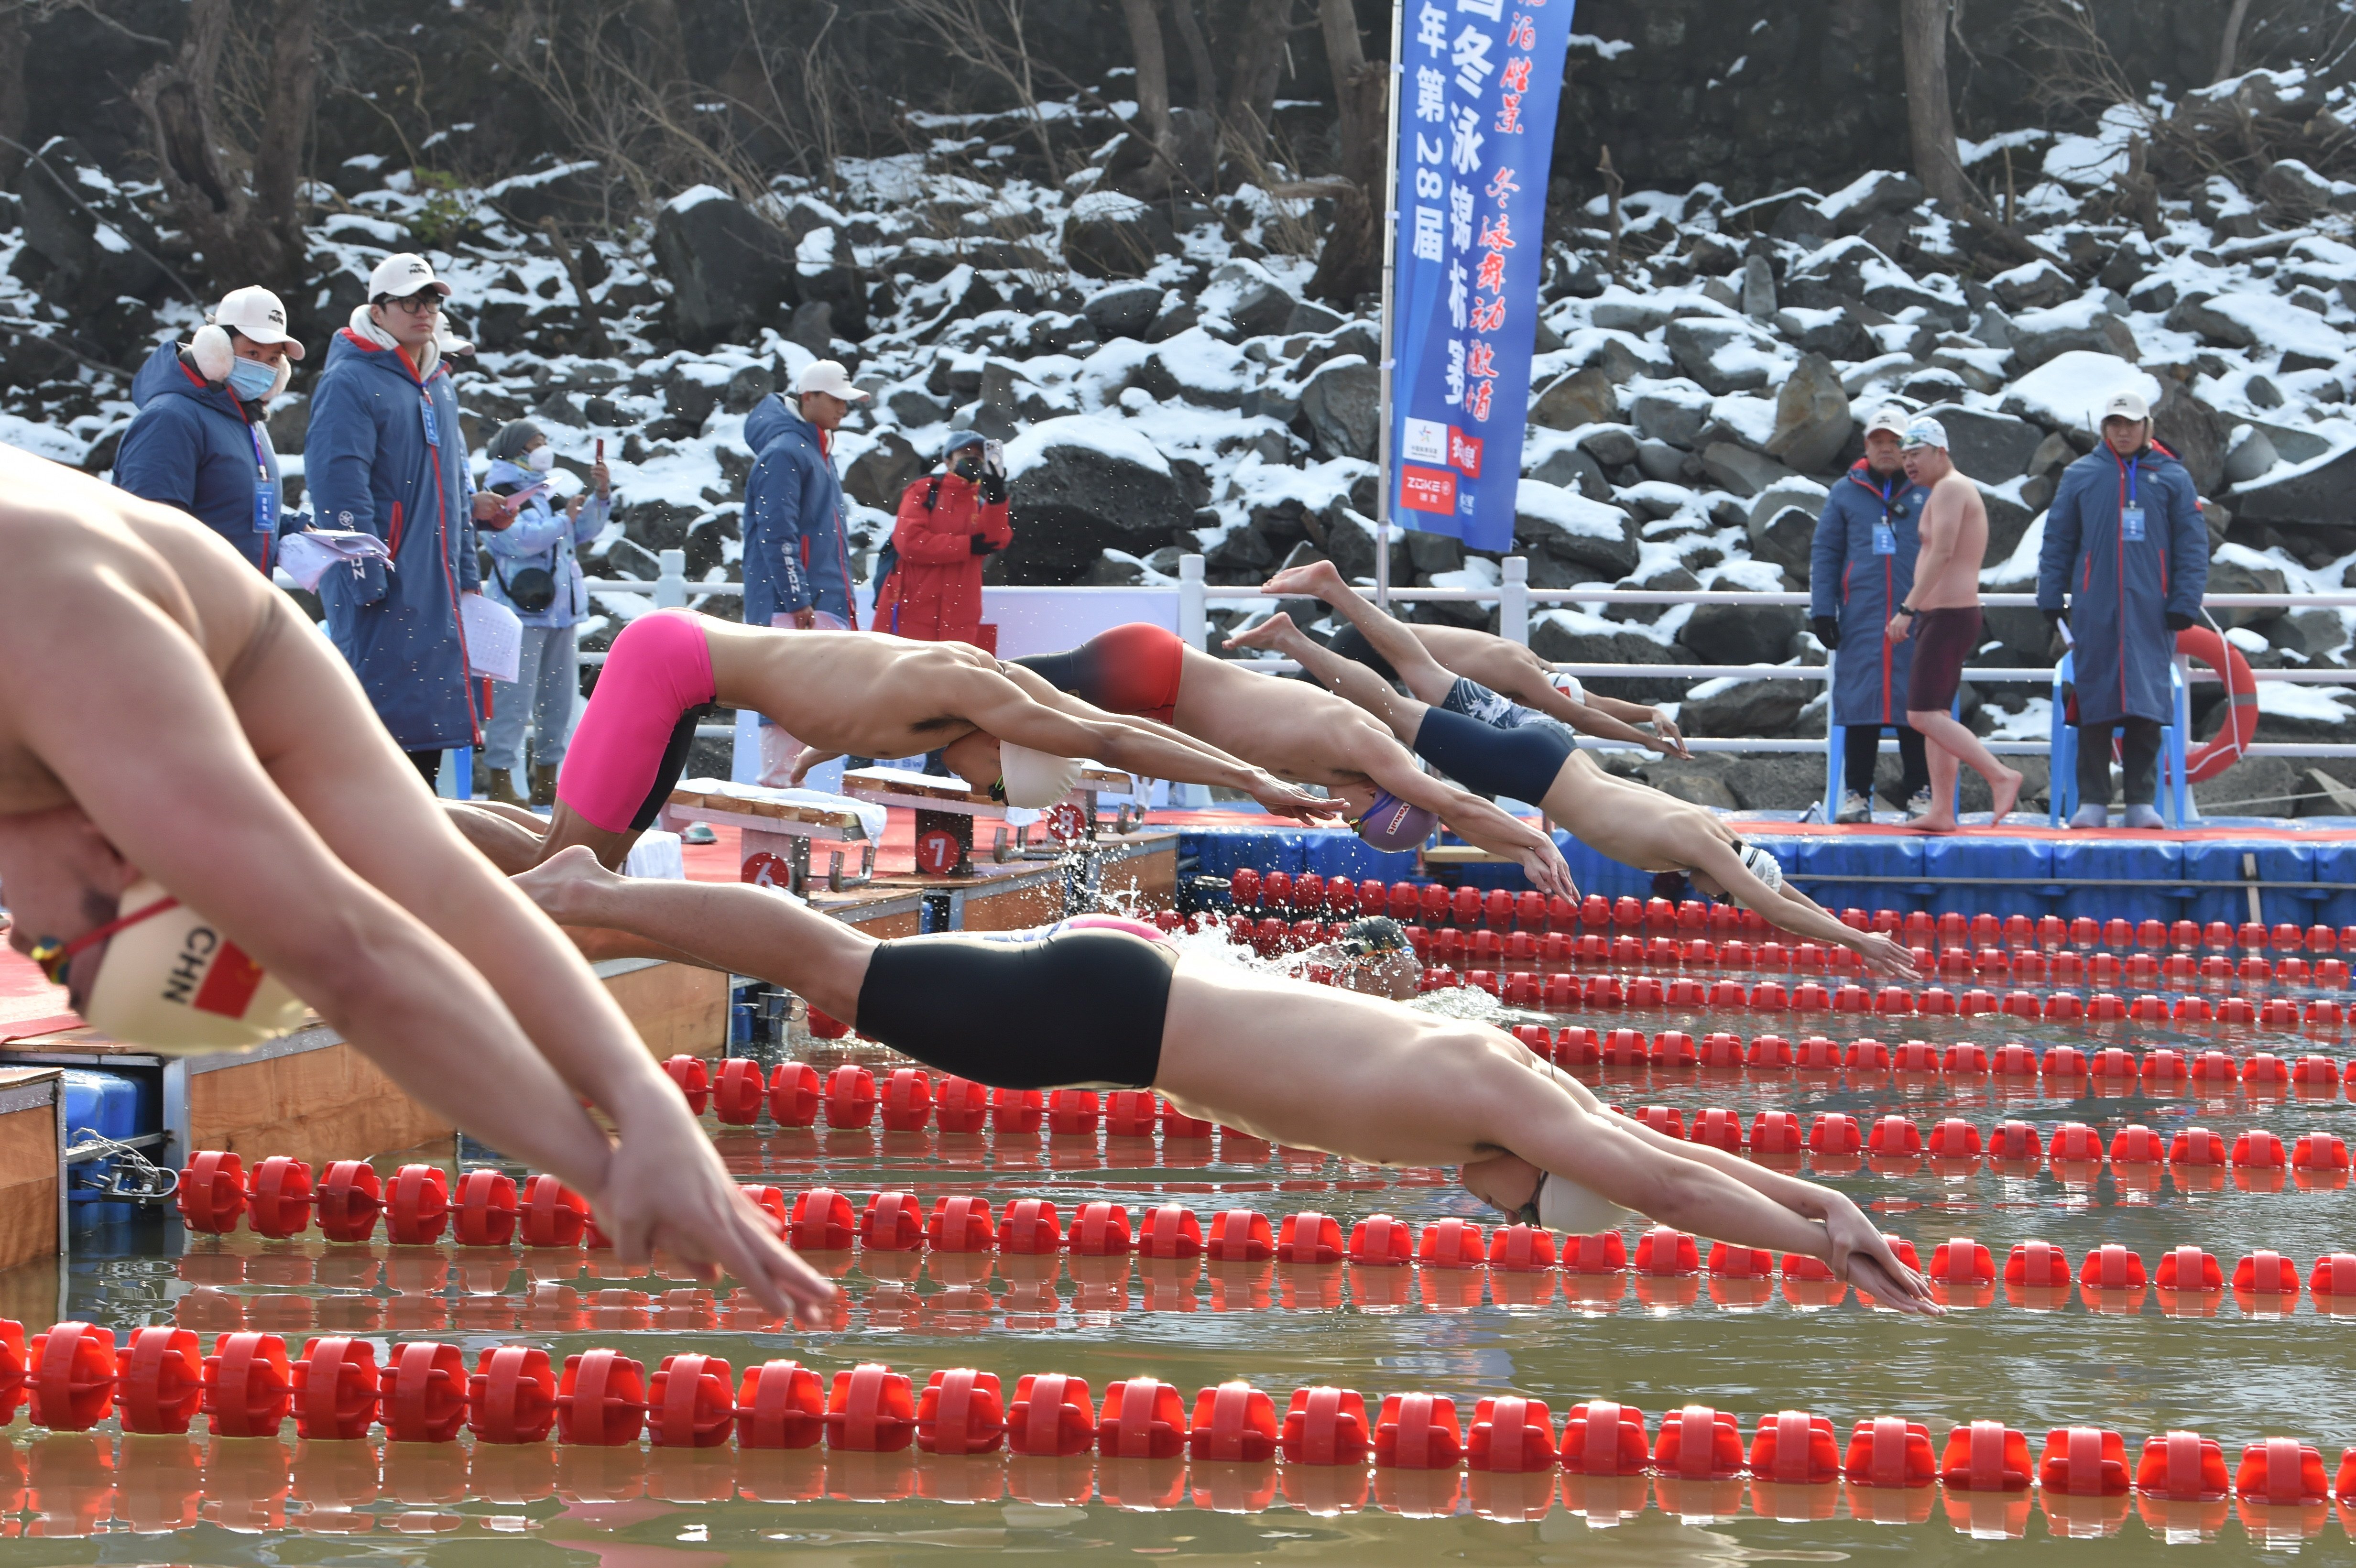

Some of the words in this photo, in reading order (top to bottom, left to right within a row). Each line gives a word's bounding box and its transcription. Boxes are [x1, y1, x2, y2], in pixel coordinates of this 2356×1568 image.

[1495, 0, 1546, 134] 泊胜景
[1407, 476, 1441, 492] ZOKE
[1058, 810, 1074, 838] 8
[1388, 805, 1410, 833] Yakult
[929, 838, 945, 867] 7
[754, 861, 773, 888] 6
[162, 926, 217, 1006] CHN
